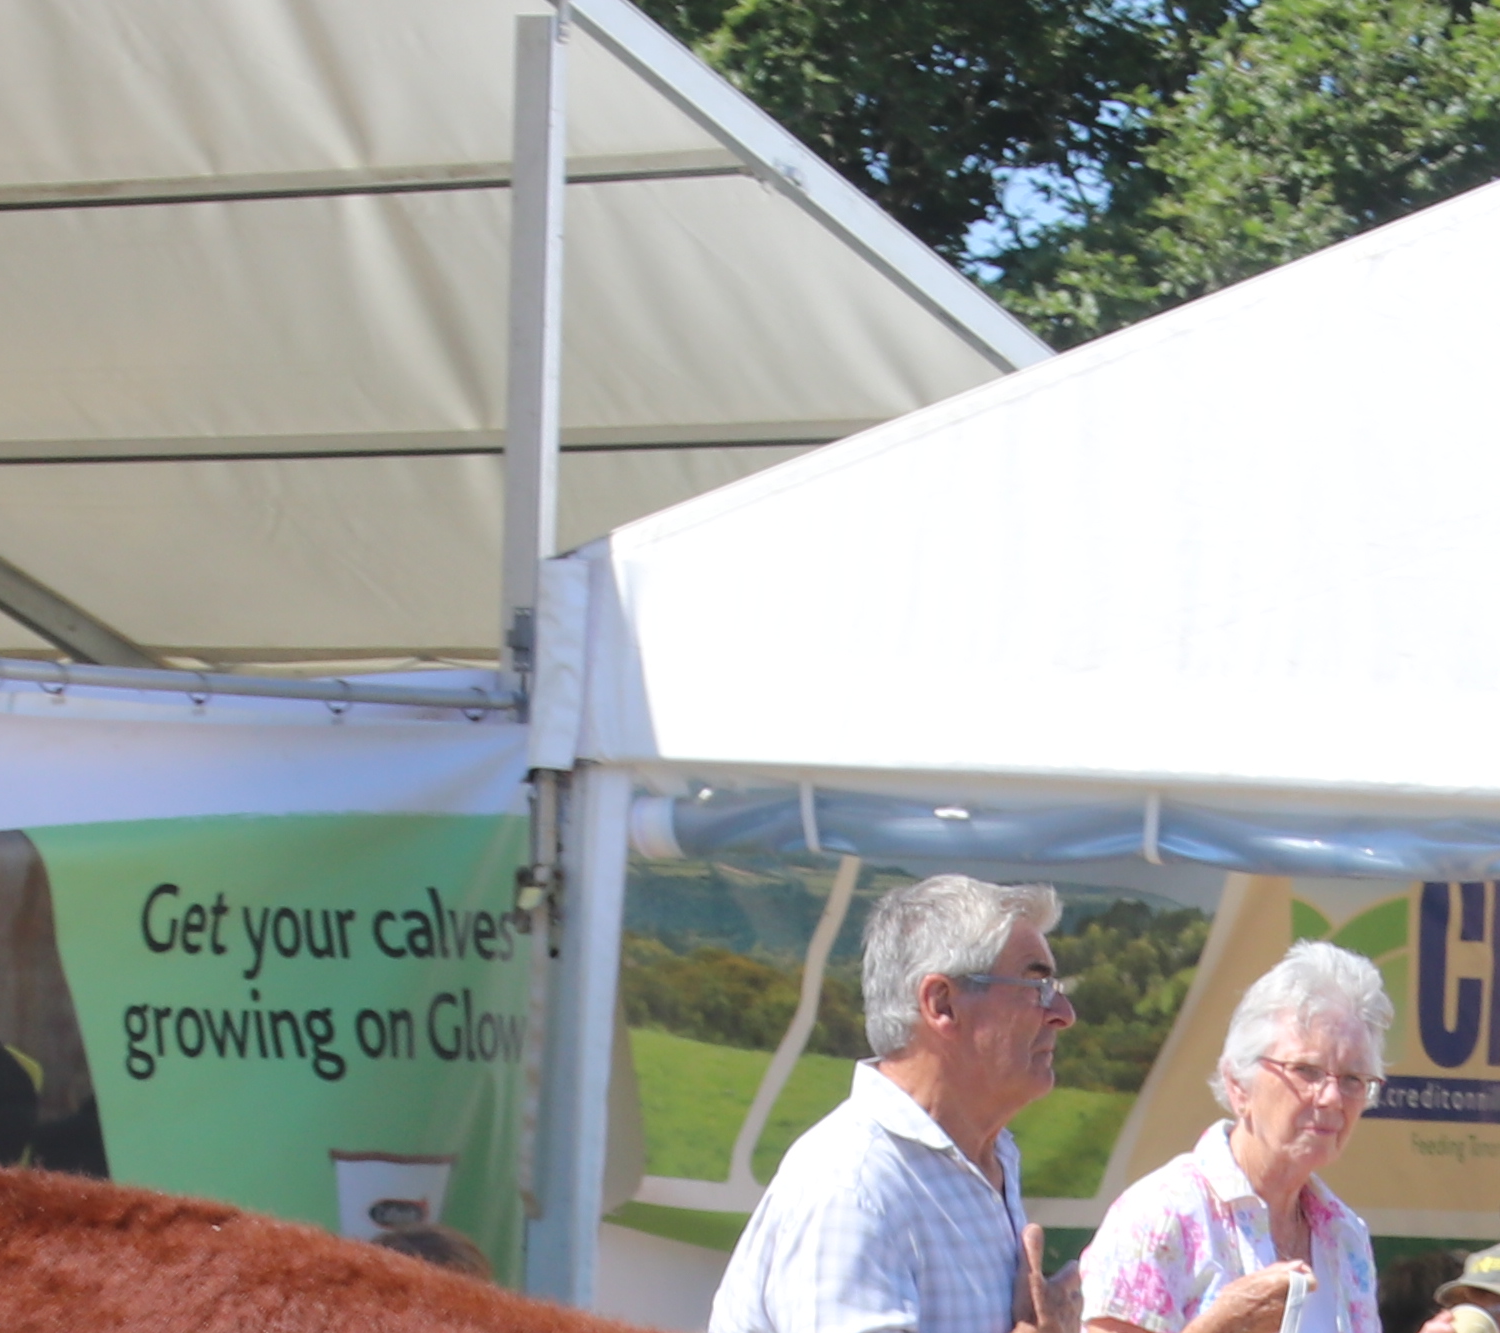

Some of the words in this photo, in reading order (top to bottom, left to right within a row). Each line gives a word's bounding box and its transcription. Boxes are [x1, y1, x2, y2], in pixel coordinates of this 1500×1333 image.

[141, 883, 229, 955] Get
[242, 907, 355, 980] your
[373, 886, 515, 960] calves
[124, 988, 347, 1081] growing
[356, 1008, 414, 1060] on
